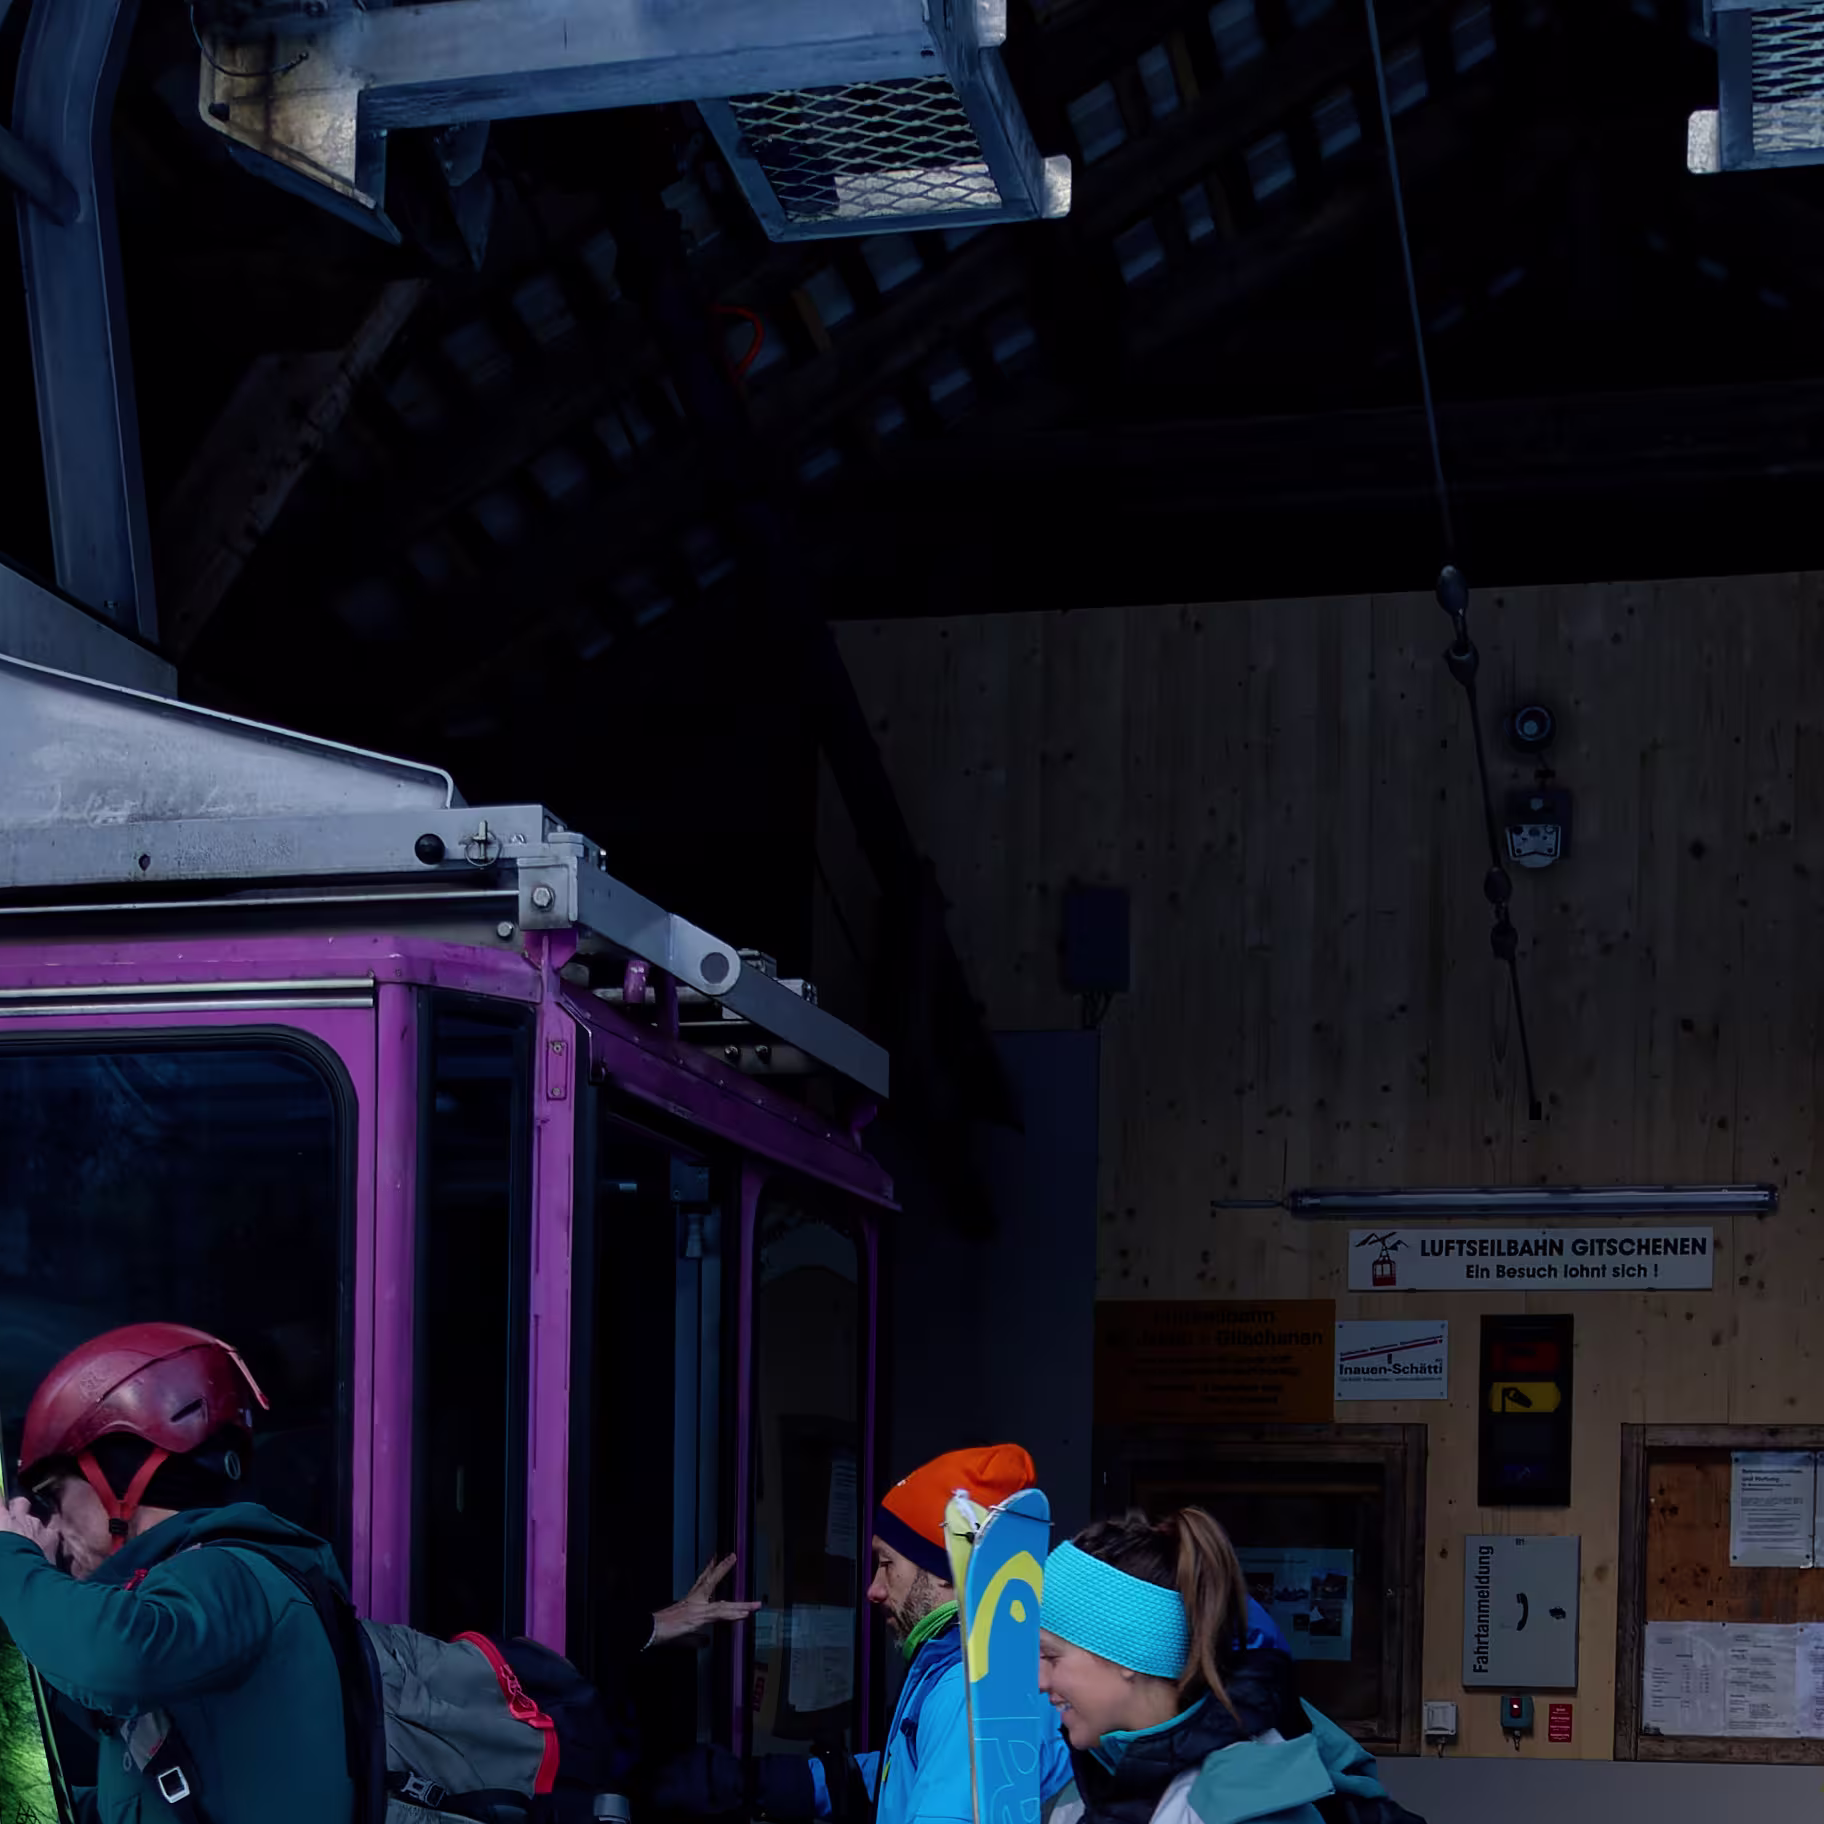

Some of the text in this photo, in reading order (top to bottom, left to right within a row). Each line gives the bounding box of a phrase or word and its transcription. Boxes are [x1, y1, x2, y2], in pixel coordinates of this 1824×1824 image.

[1420, 1237, 1707, 1257] LUFTSEILBAHN GITSCHENEN
[1465, 1263, 1659, 1279] Ein Besuch lohnt sich !
[1339, 1362, 1443, 1375] Inauen-Schätti
[1473, 1545, 1494, 1673] Fahrtanmeldung
